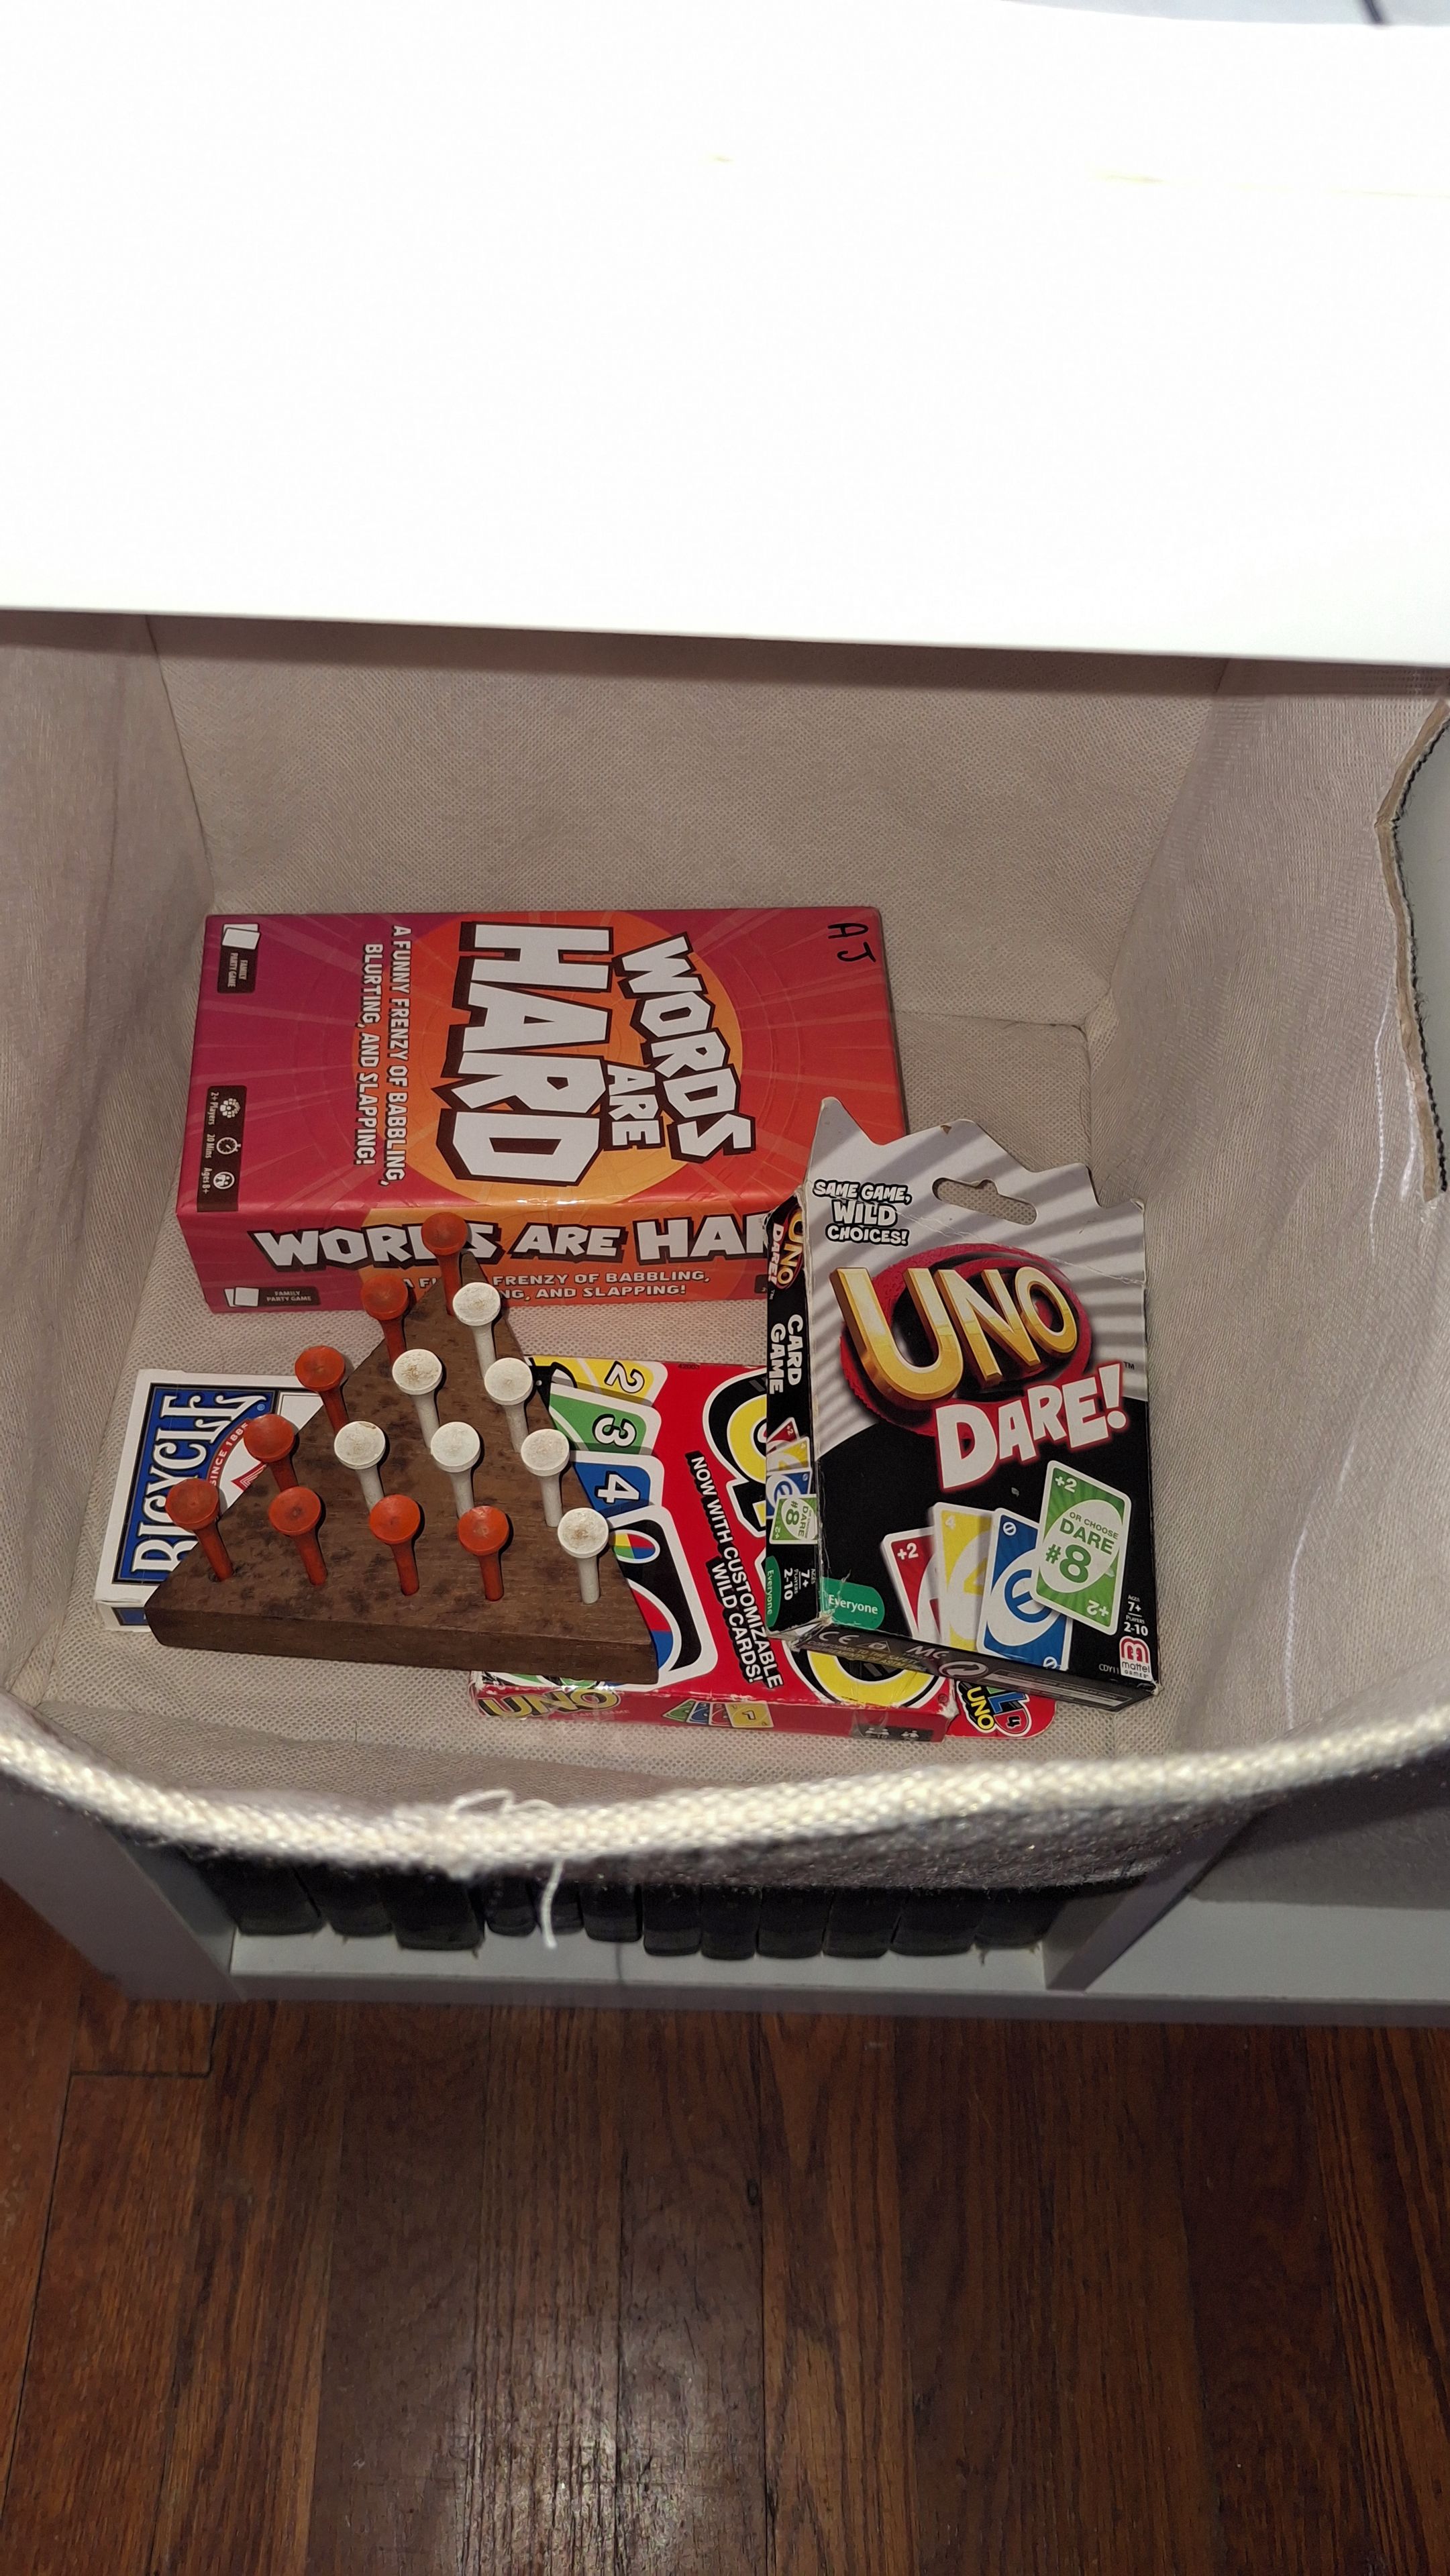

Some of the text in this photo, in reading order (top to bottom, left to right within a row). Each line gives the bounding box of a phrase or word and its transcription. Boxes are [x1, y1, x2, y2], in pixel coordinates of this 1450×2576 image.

[227, 952, 239, 988] PARTY GAME
[238, 959, 248, 980] FAMILY
[356, 943, 384, 1165] BLURTING, AND SLAPPING!
[380, 925, 412, 1186] A FUNNY FRENZY OF BABBLING,
[450, 923, 611, 1184] HARD
[621, 935, 753, 1159] WORDS
[207, 1091, 219, 1126] 2+ Players
[607, 1063, 662, 1147] ARE
[205, 1133, 215, 1159] 20 Mins
[201, 1167, 213, 1195] Ages 8+
[813, 1181, 911, 1203] SAME GAME,
[833, 1199, 897, 1226] WILD
[513, 1224, 621, 1257] ARE
[637, 1213, 768, 1260] HA
[778, 1210, 804, 1285] UNO
[827, 1225, 908, 1245] CHOICES!
[492, 1270, 711, 1286] FRENZY OF BABBLING,
[536, 1287, 576, 1299] AND
[582, 1284, 686, 1297] SLAPPING!
[786, 1313, 804, 1386] CARD
[830, 1265, 1078, 1401] UNO
[768, 1323, 786, 1395] GAME
[605, 1360, 645, 1394] 2
[592, 1413, 637, 1448] 3
[935, 1362, 1127, 1489] DARE!
[209, 1450, 227, 1487] SINCE
[1055, 1475, 1078, 1493] +2
[597, 1470, 640, 1504] 4
[785, 1499, 800, 1526] #8
[797, 1506, 809, 1538] DARE
[1069, 1511, 1119, 1540] OR CHOOSE
[896, 1542, 919, 1561] +2
[1059, 1517, 1115, 1555] DARE
[690, 1456, 784, 1688] NOW WITH CUSTOMIZABLE
[800, 1568, 811, 1588] 7+
[1045, 1544, 1092, 1584] #8
[766, 1569, 775, 1616] Everyone
[784, 1567, 794, 1601] 2-10
[827, 1594, 879, 1615] Everyone
[1127, 1601, 1142, 1612] 7+
[711, 1562, 764, 1684] WILD CARDS!
[1123, 1621, 1149, 1636] 2-10
[1121, 1660, 1150, 1673] mattel
[478, 1688, 621, 1717] UNO
[967, 1686, 994, 1731] UNO
